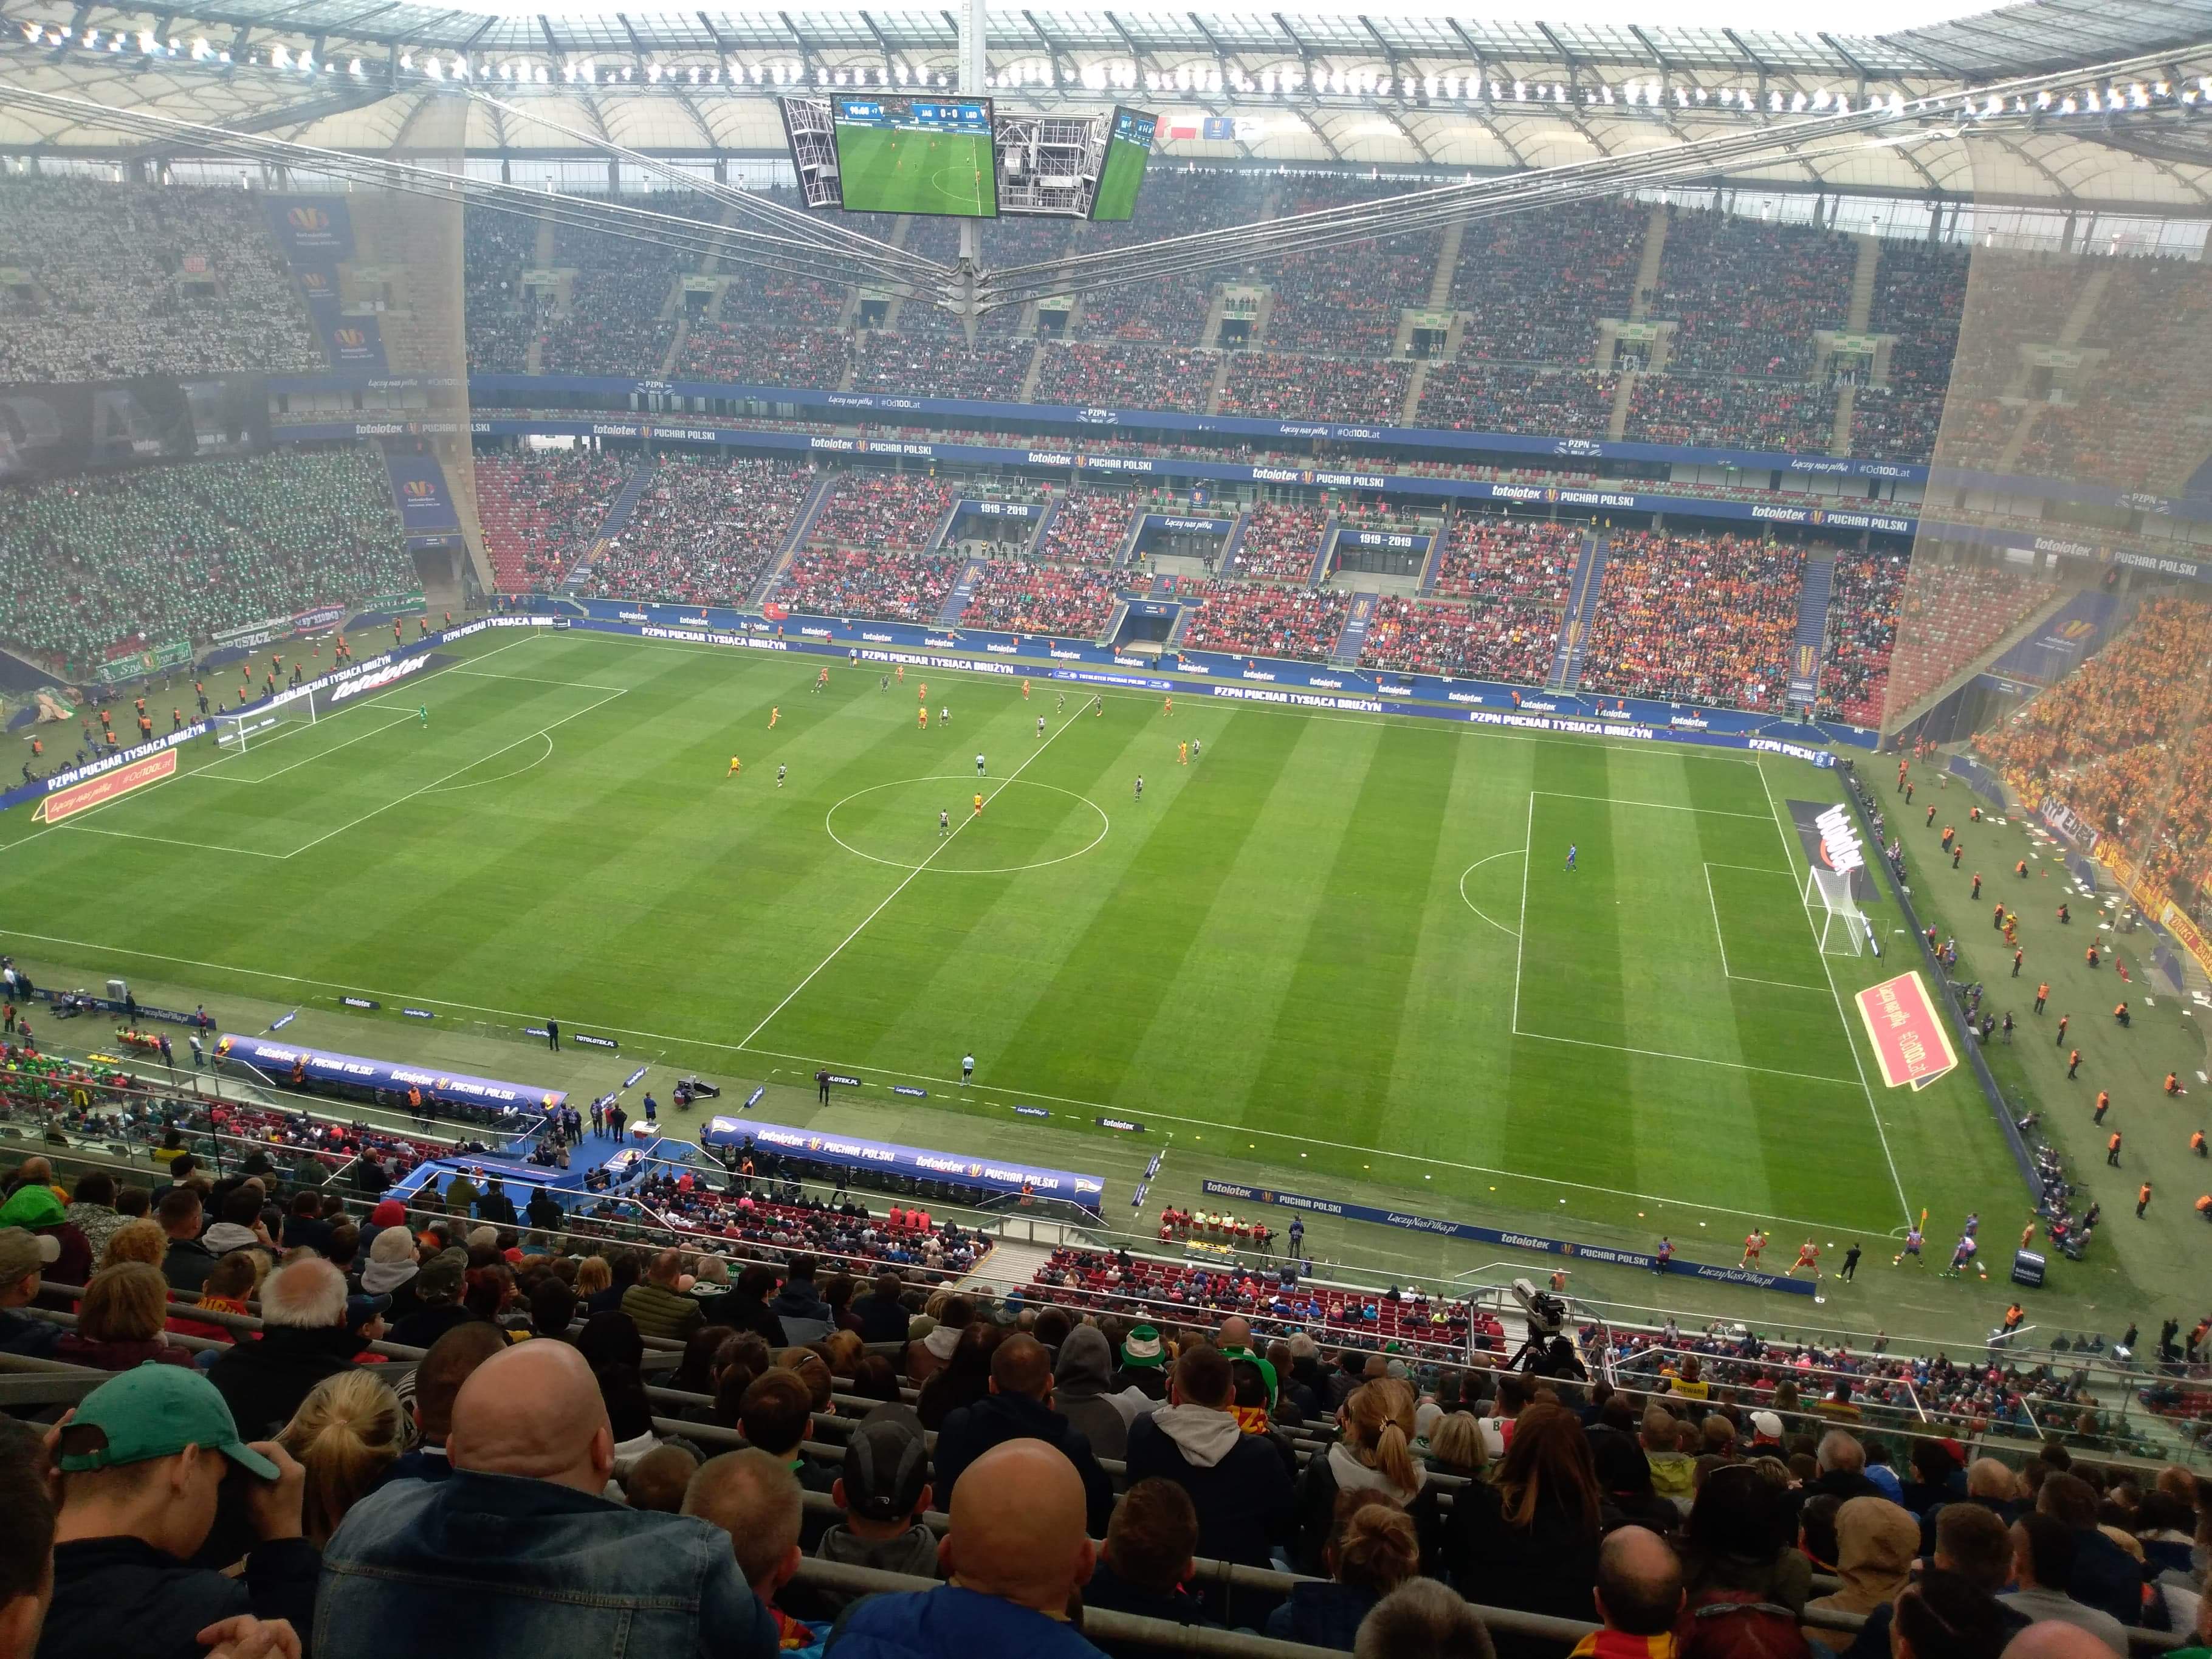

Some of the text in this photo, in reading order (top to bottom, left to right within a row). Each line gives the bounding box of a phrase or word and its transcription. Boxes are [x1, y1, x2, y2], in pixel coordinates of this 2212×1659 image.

[645, 381, 664, 390] PZPN
[881, 399, 921, 409] #Od100Lat
[1088, 409, 1107, 417] PZPN
[593, 424, 715, 441] totolotek PUCHAR POLSKI
[1336, 428, 1380, 439] #Od100Lat
[811, 437, 931, 455] totolotek PUCHAR POLSKI
[1568, 440, 1590, 449] PZPN
[1028, 452, 1152, 471] totolotek PUCHAR POLSKI
[1252, 467, 1384, 487] totolotek PUCHAR POLSKI
[1859, 464, 1911, 478] #Od100Lat
[1492, 485, 1633, 507] totolotek PUCHAR POLSKI
[2132, 493, 2157, 505] PZPN
[1751, 505, 1908, 532] totolotek PUCHAR POLSKI
[2034, 537, 2198, 577] totolotek PUCHAR POLSKI
[619, 611, 648, 620] totolotek
[679, 617, 709, 626] totolotek
[442, 632, 461, 643] PZPN
[461, 620, 486, 637] PUCHAR
[486, 617, 530, 627] TYSIĄCA
[642, 627, 667, 638] PZPN
[668, 630, 706, 642] PUCHAR
[707, 634, 747, 647] TYSIĄCA
[862, 632, 892, 642] totolotek
[924, 637, 954, 648] totolotek
[987, 644, 1017, 653] totolotek
[1050, 650, 1081, 659] totolotek
[862, 650, 888, 662] PZPN
[890, 653, 928, 666] PUCHAR
[930, 656, 972, 671] TYSIĄCA
[1114, 656, 1144, 667] totolotek
[329, 667, 362, 684] TYSIĄCA
[362, 655, 391, 672] DRUŻYN
[1178, 663, 1209, 673] totolotek
[331, 653, 432, 701] totolotek
[1243, 670, 1275, 681] totolotek
[1309, 677, 1342, 689] totolotek
[1378, 684, 1411, 696] totolotek
[1214, 686, 1243, 698] PZPN
[1244, 689, 1288, 703] PUCHAR
[1290, 694, 1335, 708] TYSIĄCA
[1449, 692, 1483, 704] totolotek
[1520, 699, 1556, 711] totolotek
[1470, 711, 1502, 724] PZPN
[1503, 715, 1550, 729] PUCHAR
[1552, 720, 1602, 735] TYSIĄCA
[1671, 716, 1708, 727] totolotek
[1749, 739, 1781, 752] PZPN
[47, 772, 78, 790] PZPN
[80, 755, 123, 778] PUCHAR
[123, 739, 167, 762] TYSIĄCA
[122, 758, 172, 785] #Od100Lat
[1815, 803, 1864, 876] totolotek
[345, 997, 370, 1008] totolotek
[575, 1034, 615, 1047] TOTOLOTEK.PL
[1897, 1030, 1929, 1076] #Od100Lat
[255, 1046, 374, 1076] totolotek PUCHAR POLSKI
[390, 1070, 516, 1101] totolotek PUCHAR POLSKI
[1103, 1118, 1135, 1131] totolotek
[757, 1129, 895, 1162] totolotek PUCHAR POLSKI
[915, 1155, 1060, 1189] totolotek PUCHAR POLSKI
[1207, 1181, 1342, 1214] totolotek PUCHAR POLSKI
[1501, 1233, 1649, 1266] totolotek PUCHAR POLSKI
[1676, 1386, 1705, 1396] STEWARD
